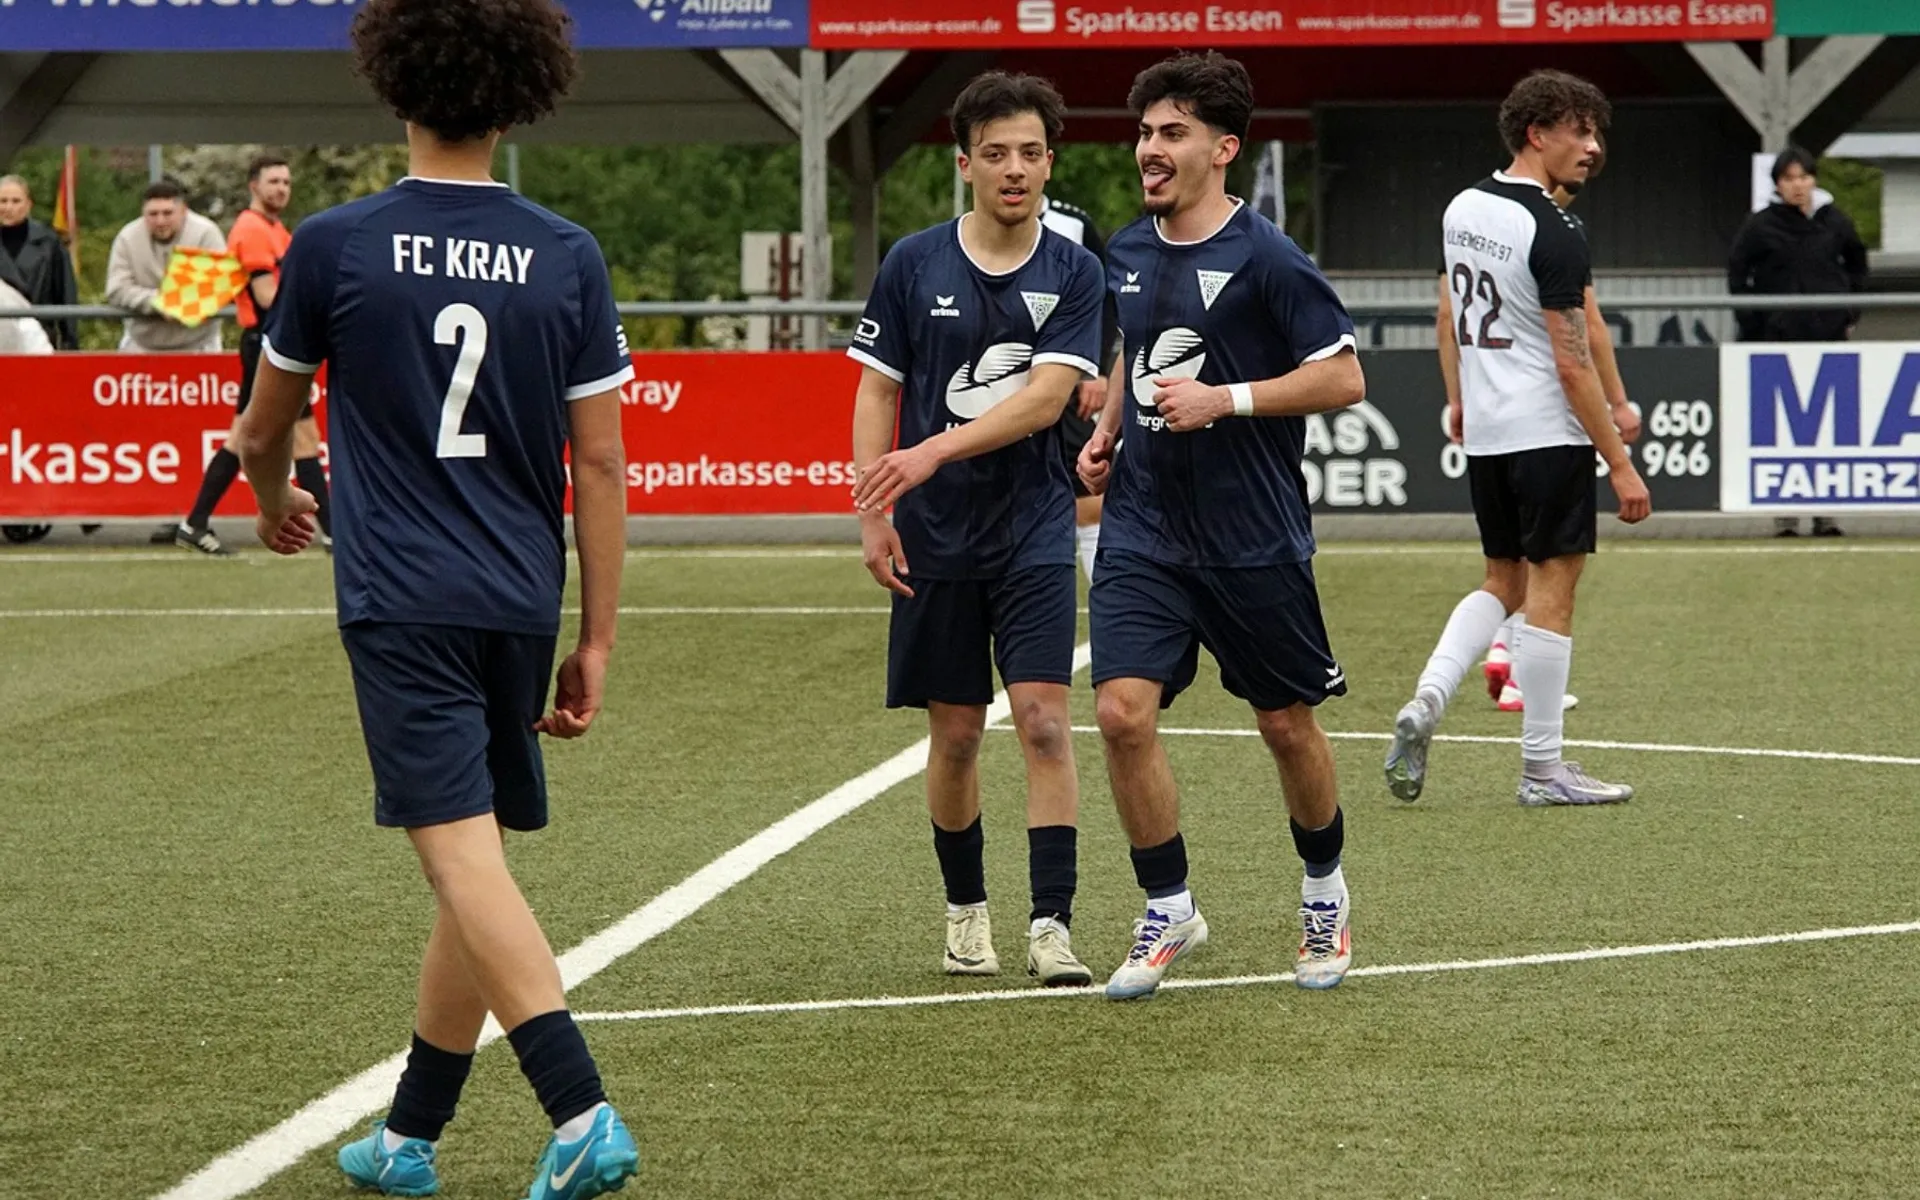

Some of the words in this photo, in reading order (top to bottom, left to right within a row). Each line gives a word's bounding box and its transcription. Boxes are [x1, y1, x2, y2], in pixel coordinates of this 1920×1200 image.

[1065, 6, 1199, 38] Sparkasse
[1206, 6, 1283, 31] Essen
[1546, 3, 1682, 33] Sparkasse
[1689, 1, 1766, 25] Essen
[392, 234, 434, 275] FC
[445, 237, 534, 284] KRAY
[1498, 244, 1513, 262] 97
[930, 308, 960, 317] erima
[1452, 262, 1514, 350] 22
[434, 302, 488, 458] 2
[1649, 400, 1713, 437] 650
[0, 428, 180, 484] kasse
[627, 453, 857, 495] sparkasse-ess
[1642, 440, 1710, 477] 966
[1754, 462, 1920, 499] FAHRZ
